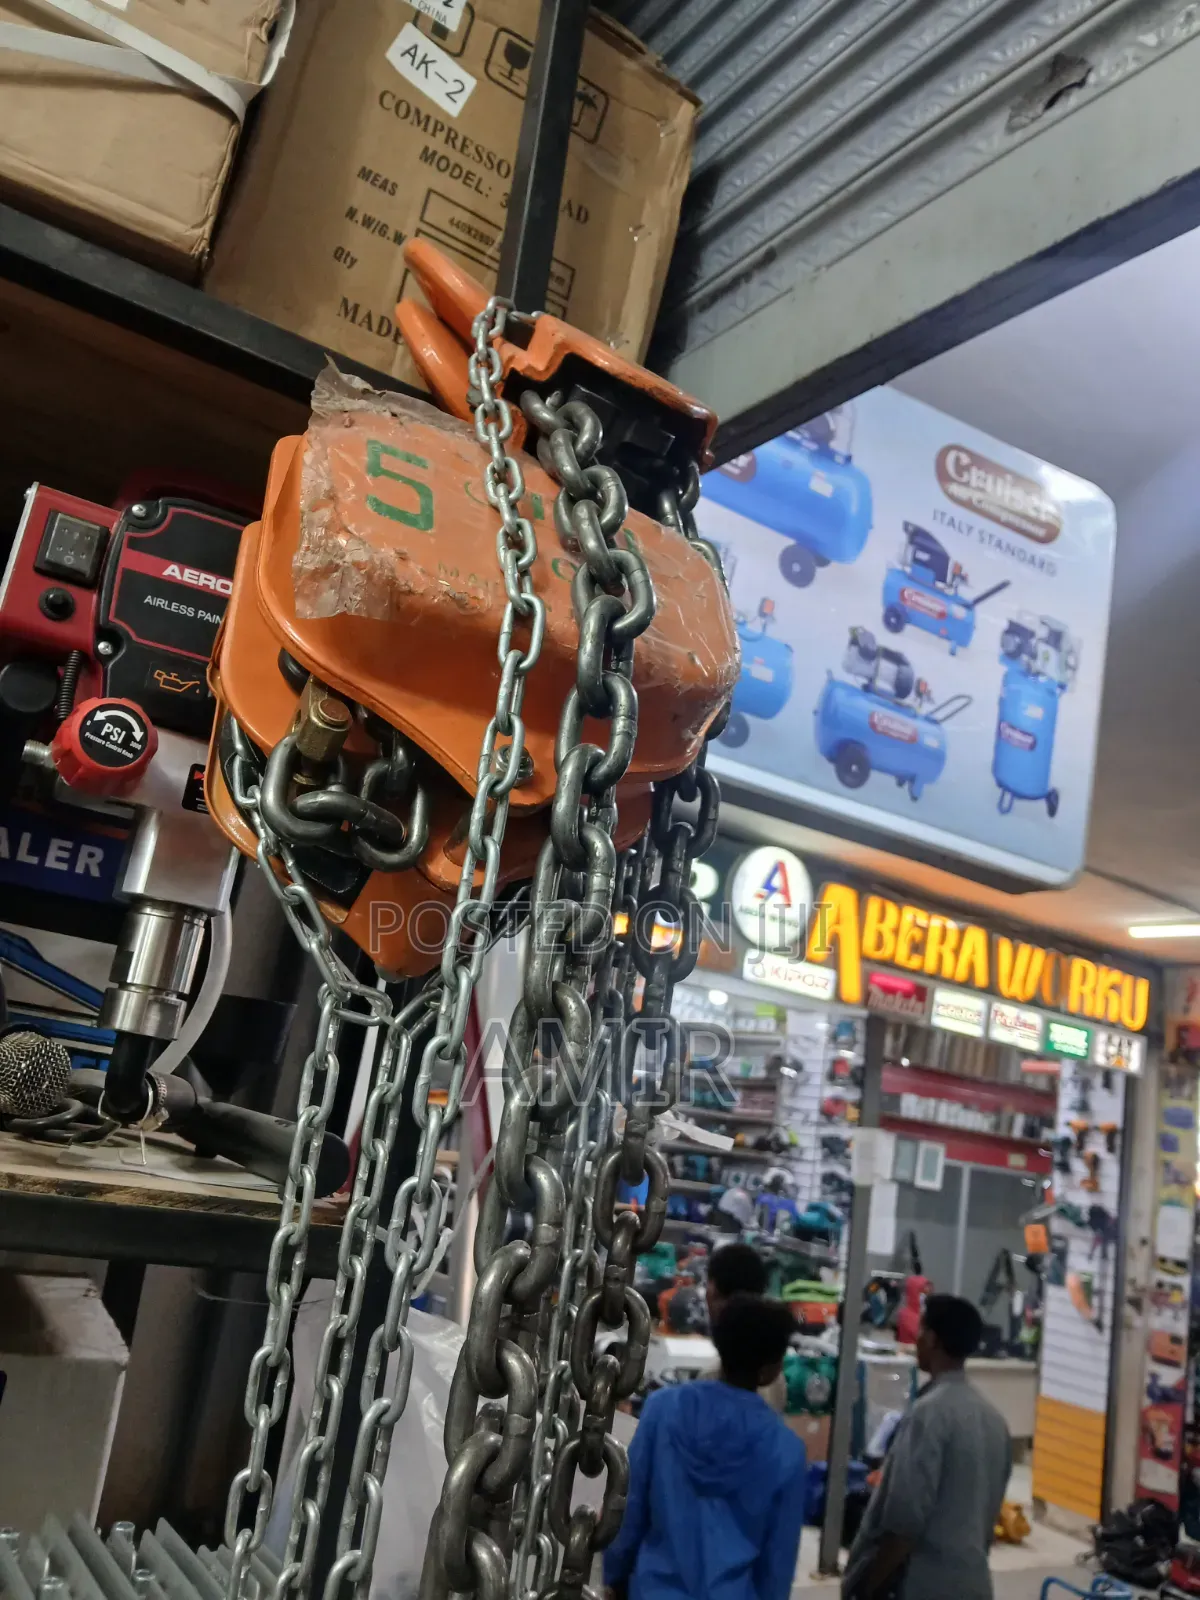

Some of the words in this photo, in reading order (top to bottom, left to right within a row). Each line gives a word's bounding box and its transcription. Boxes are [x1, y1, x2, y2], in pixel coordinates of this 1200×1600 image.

[400, 43, 465, 104] AK-2
[357, 165, 399, 197] MEAS
[418, 145, 493, 198] MODEL:
[333, 246, 358, 269] Qty
[932, 507, 974, 537] ITALY
[977, 527, 1057, 577] STANDARD
[162, 564, 233, 595] AERO
[143, 594, 195, 617] AIRLESS
[100, 723, 127, 745] PSI
[805, 882, 990, 1004] ABERA
[995, 935, 1151, 1032] WORKU
